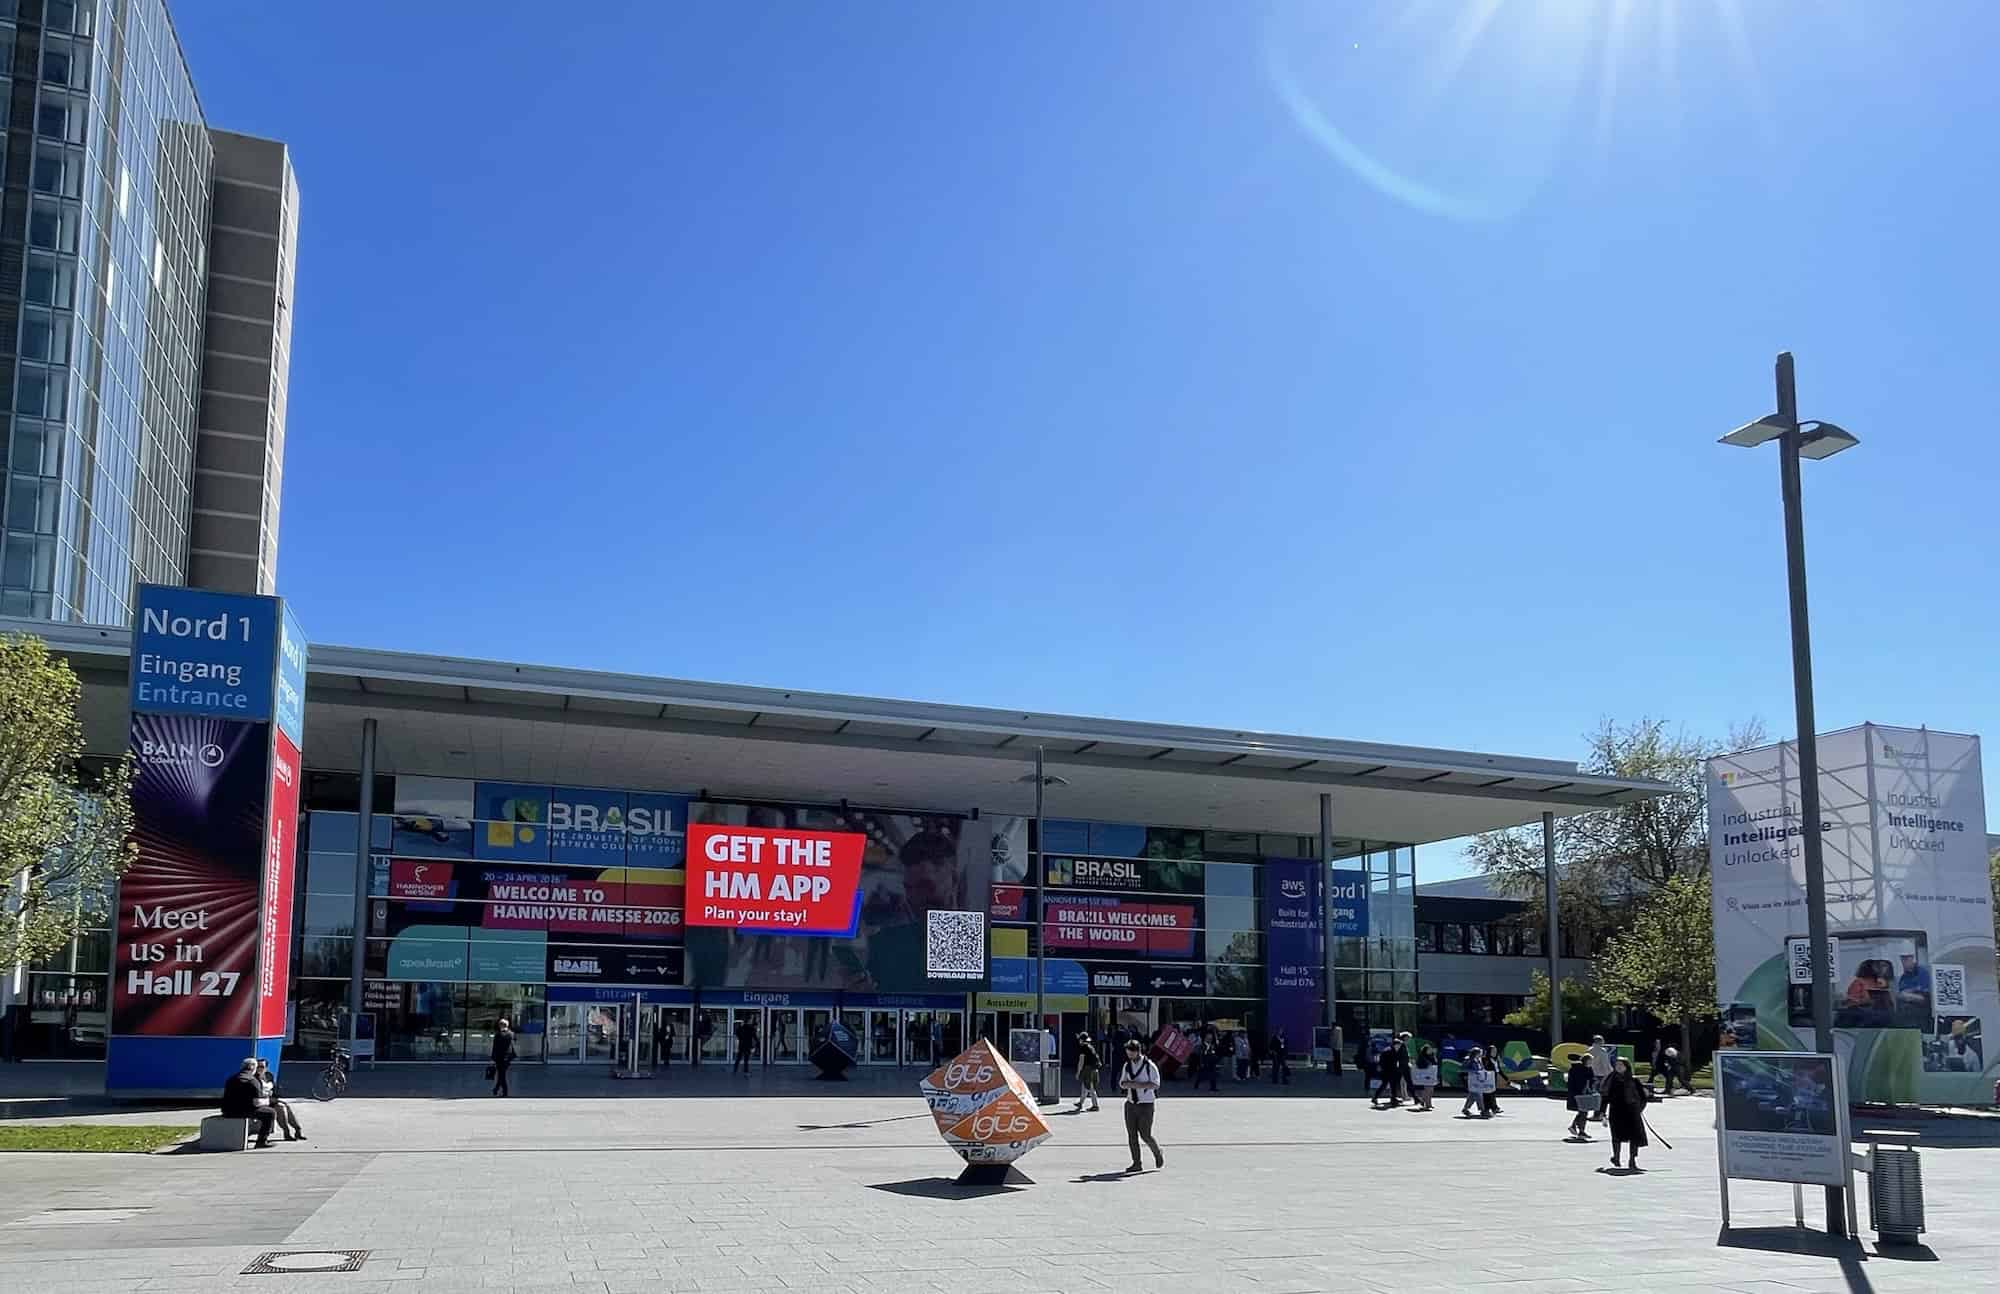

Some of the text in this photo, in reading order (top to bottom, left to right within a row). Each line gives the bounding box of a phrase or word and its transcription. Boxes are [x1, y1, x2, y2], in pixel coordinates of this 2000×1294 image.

[143, 607, 250, 641] Nord 1
[140, 654, 242, 687] Eingang
[138, 682, 248, 708] Entrance
[142, 740, 193, 757] BAIN
[1886, 790, 1941, 809] Industrial
[546, 802, 685, 837] BRASIL
[1722, 801, 1797, 827] Industrial
[1887, 812, 1965, 833] Intelligence
[1723, 819, 1832, 847] Intelligee
[1889, 835, 1945, 851] Unlocked
[704, 834, 832, 867] GET THE
[1724, 843, 1801, 867] Unlocked
[484, 872, 496, 881] 20
[1074, 861, 1142, 879] BRASIL
[492, 885, 605, 903] WELCOME TO
[704, 871, 832, 903] HM APP
[1281, 879, 1305, 890] aws
[1360, 884, 1369, 900] 1
[132, 904, 209, 930] Meet
[492, 903, 681, 925] HANNOVER MESSE 2026
[704, 905, 807, 926] Plan your stay!
[1107, 911, 1177, 927] WELCOMES
[1058, 927, 1136, 942] THE WORLD
[129, 938, 203, 963] us in
[553, 959, 602, 974] BRASIL
[127, 969, 241, 996] Hall 27
[743, 990, 790, 1006] Eingang
[943, 1059, 994, 1090] igus
[970, 1111, 1031, 1141] igus
